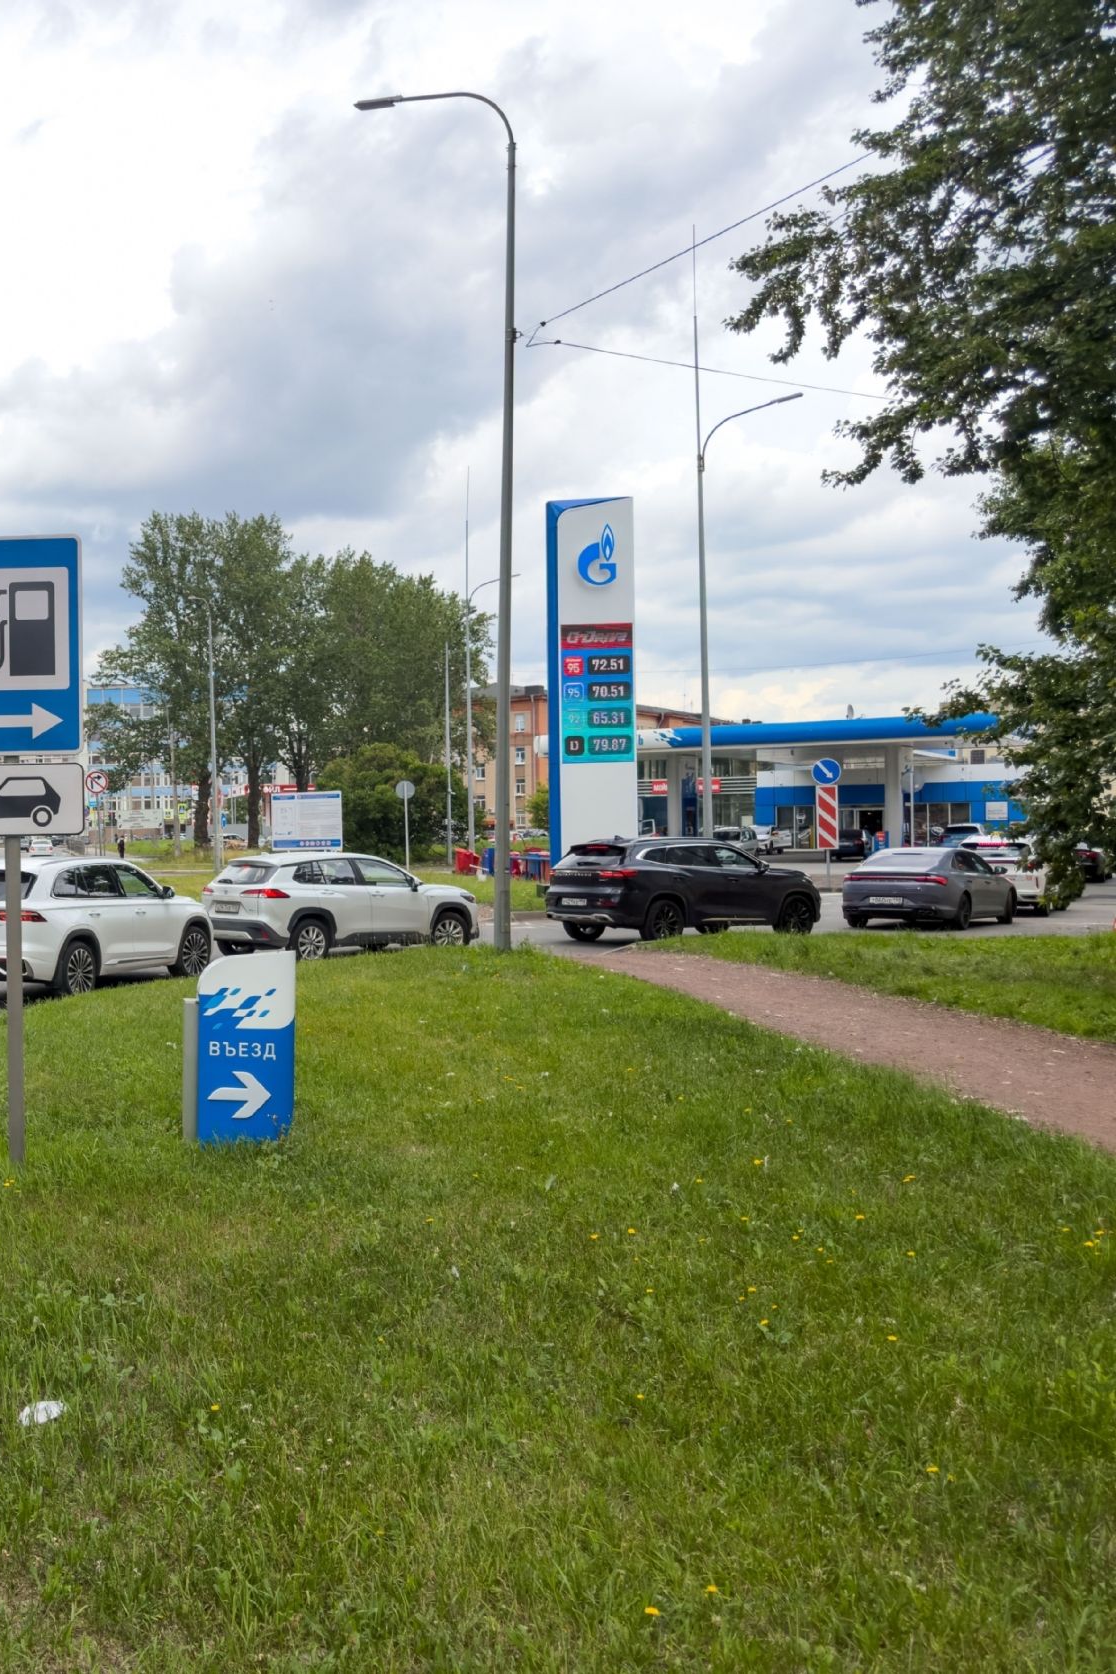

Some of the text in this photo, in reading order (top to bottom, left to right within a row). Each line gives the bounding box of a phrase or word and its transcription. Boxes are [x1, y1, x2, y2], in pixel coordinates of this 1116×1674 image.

[567, 658, 625, 674] 95 72.51
[567, 685, 625, 699] 95 70.51
[592, 711, 625, 725] 65.31
[209, 1041, 277, 1061] ВЪЕЗД
